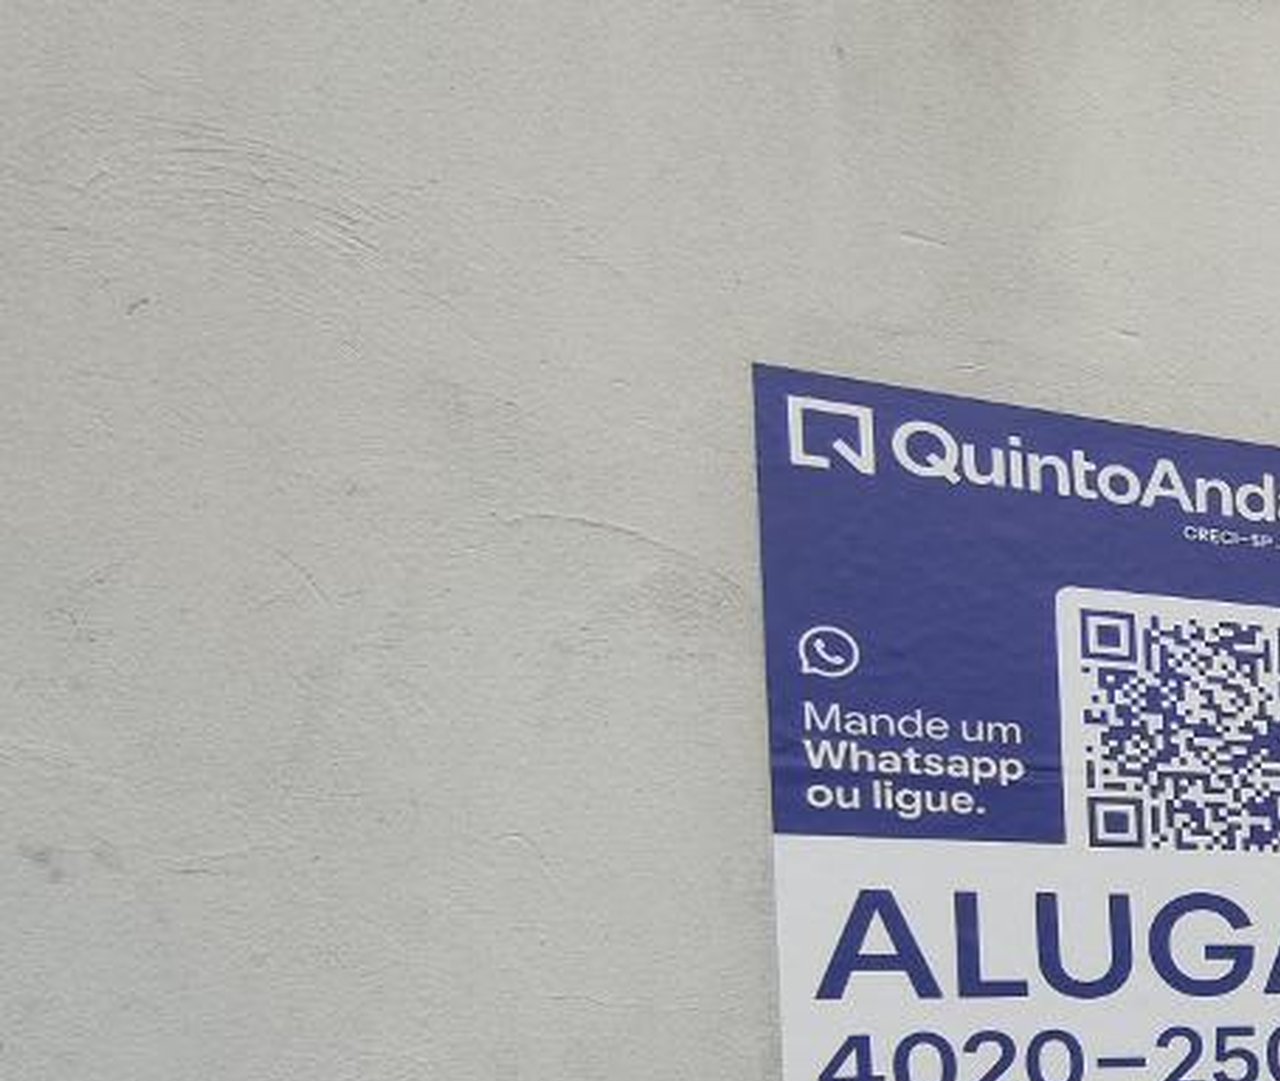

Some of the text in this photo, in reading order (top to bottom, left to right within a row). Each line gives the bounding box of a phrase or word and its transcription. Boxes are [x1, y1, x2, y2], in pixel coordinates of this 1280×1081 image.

[803, 700, 1022, 745] Mande um
[803, 738, 1024, 786] Whatsapp
[806, 774, 987, 819] ou ligue.
